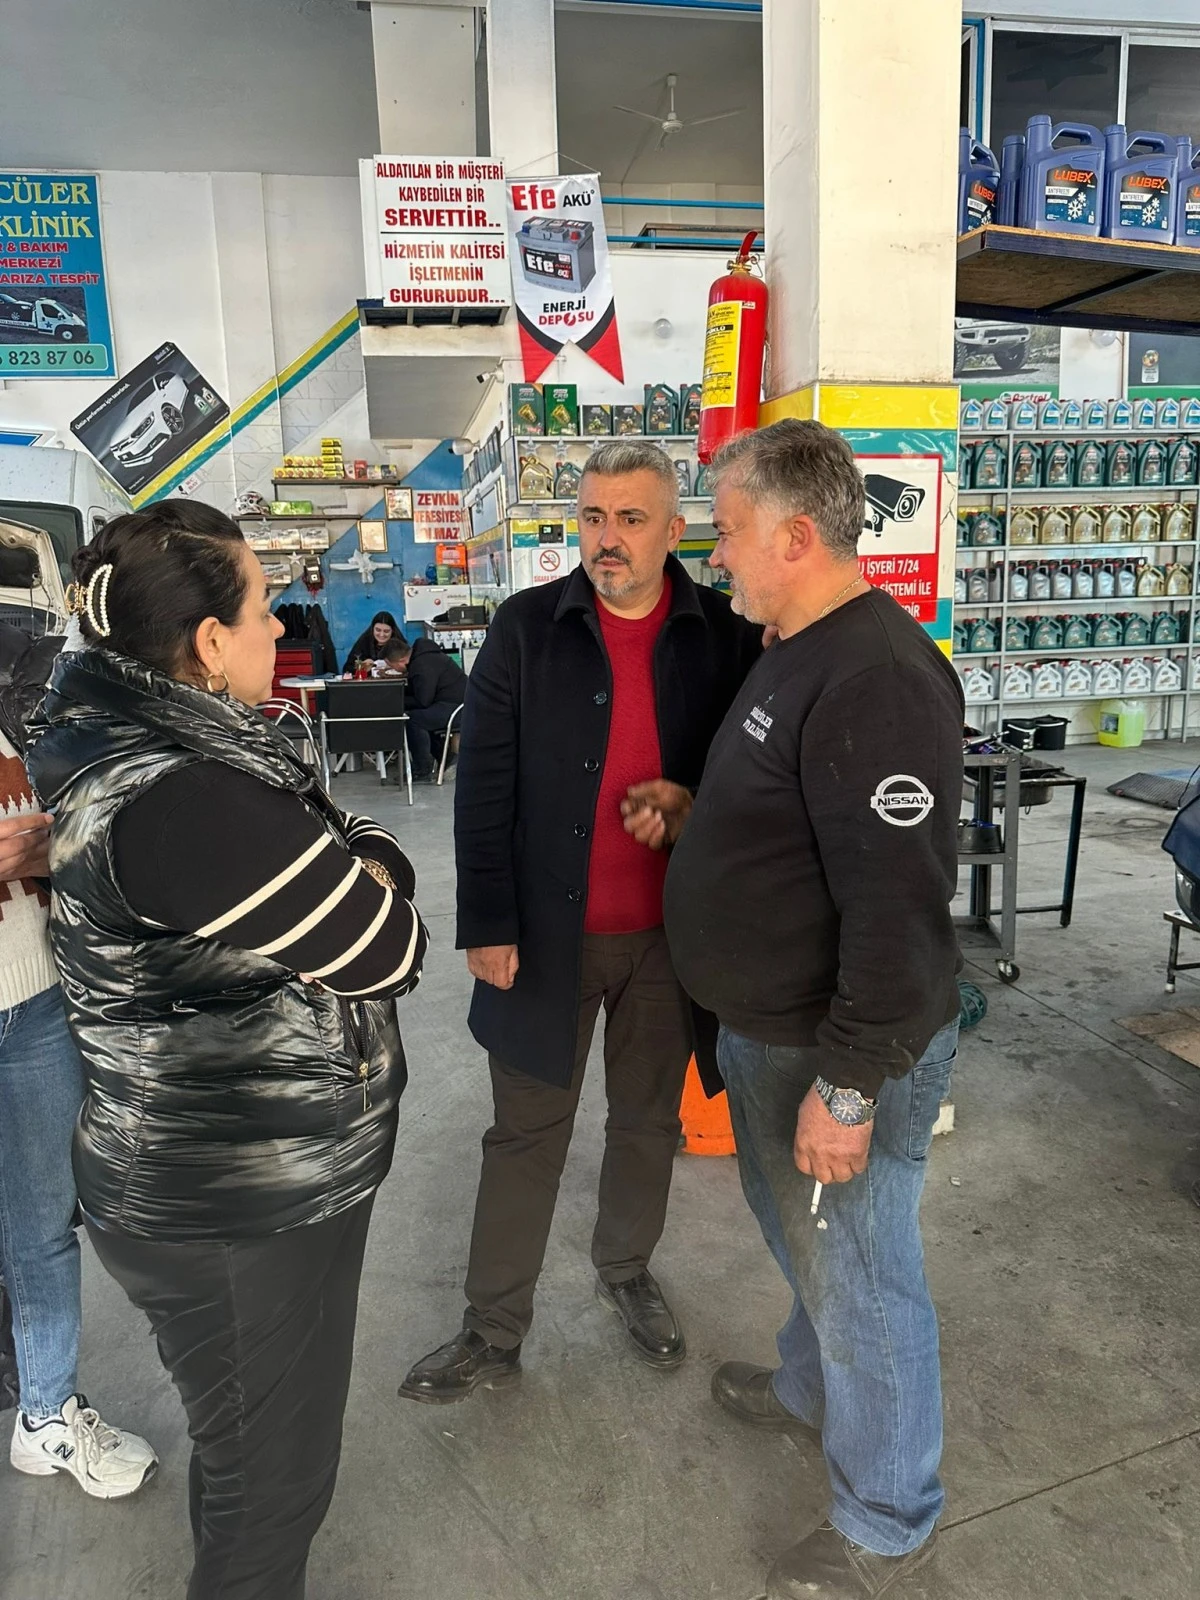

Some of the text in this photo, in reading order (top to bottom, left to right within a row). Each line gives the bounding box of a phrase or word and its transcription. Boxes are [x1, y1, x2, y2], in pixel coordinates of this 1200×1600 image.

[376, 161, 504, 183] ALDATILAN BİR MÜŞTERİ
[1054, 170, 1094, 183] LUBEX
[1128, 176, 1167, 189] LUBEX
[399, 184, 484, 202] KAYBEDİLEN BİR
[511, 184, 556, 210] Efe
[0, 210, 94, 238] KLİNİK
[385, 205, 501, 227] SERVETTİR..
[20, 242, 68, 253] BAKIM
[384, 240, 504, 260] HİZMETİN KALİTESİ
[0, 256, 62, 268] MERKEZİ
[526, 253, 554, 273] Efe
[0, 272, 100, 284] ARIZA TESPİT
[410, 262, 484, 284] İŞLETMENİN
[390, 288, 505, 304] GURURUDUR...
[543, 296, 586, 313] ENERJİ
[8, 350, 94, 366] 823 87 06
[417, 490, 459, 506] ZEVKİN
[866, 557, 896, 578] İŞYERİ
[898, 558, 919, 576] 7/24
[919, 579, 932, 594] İLE
[878, 796, 928, 806] NISSAN
